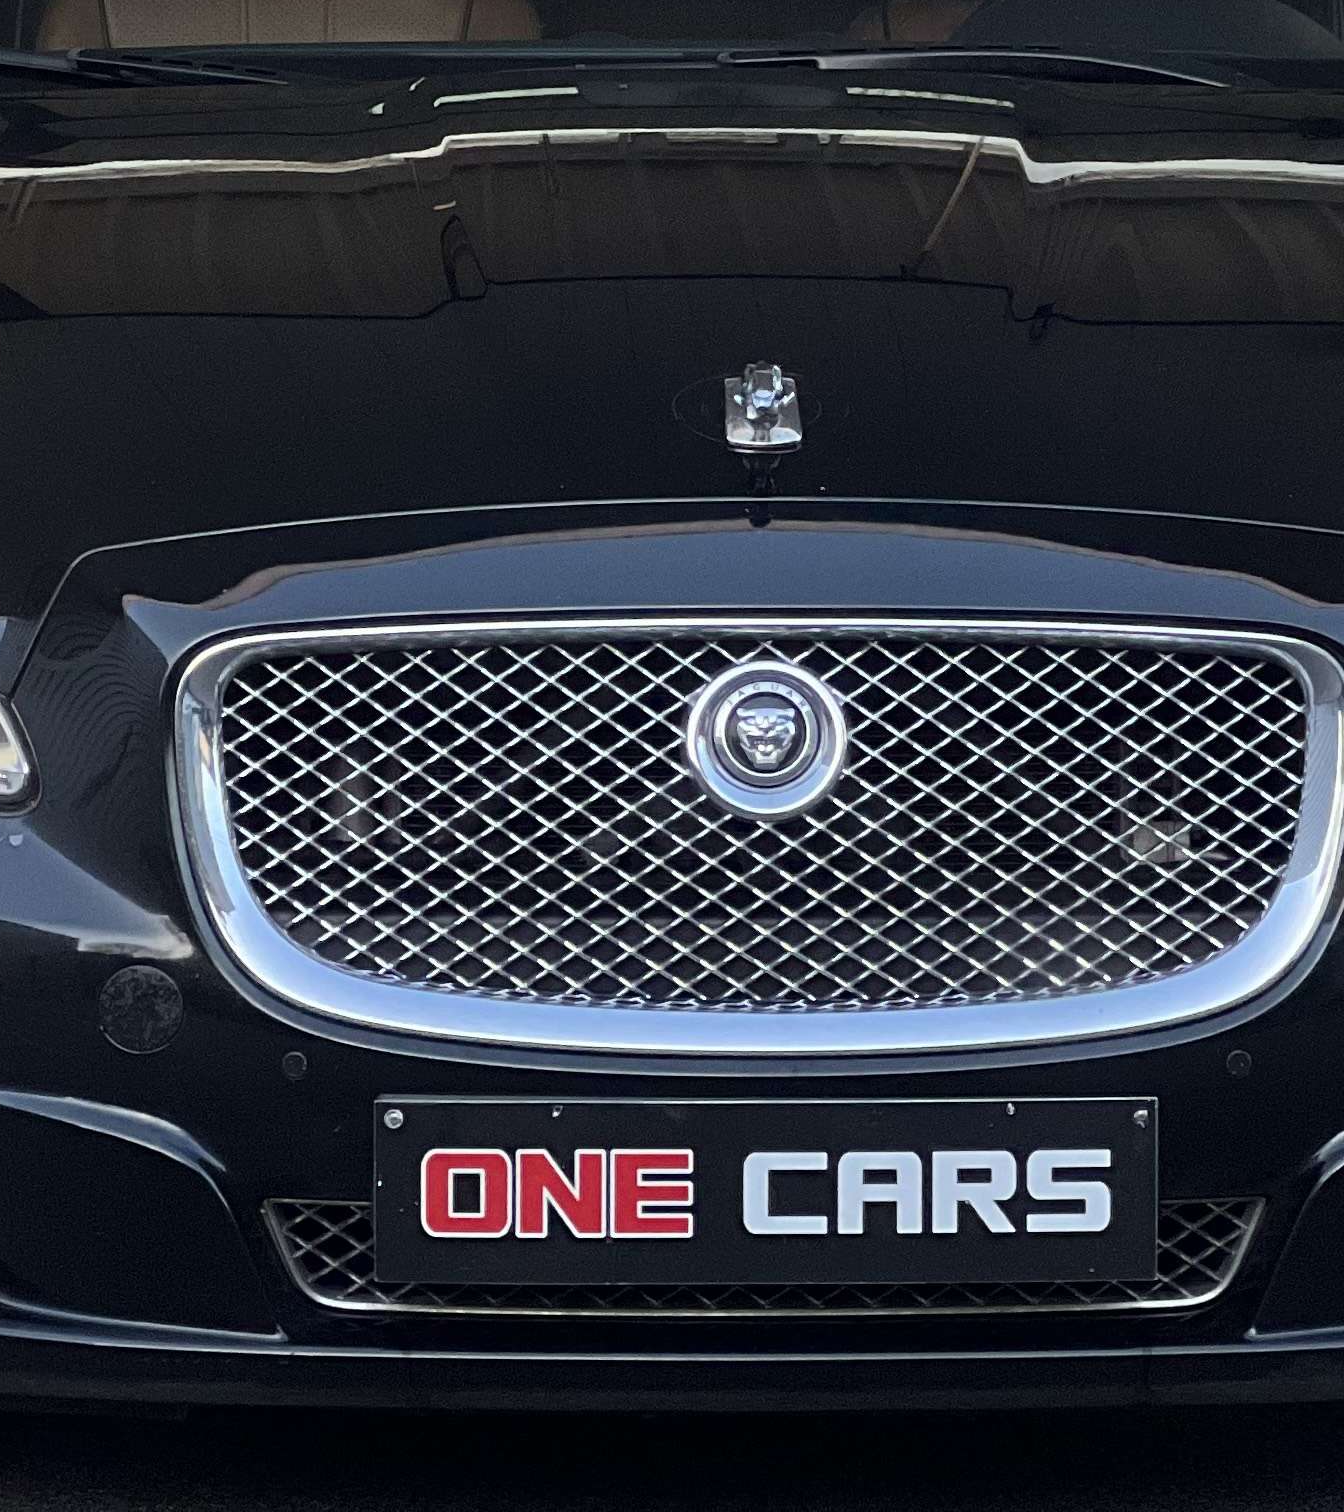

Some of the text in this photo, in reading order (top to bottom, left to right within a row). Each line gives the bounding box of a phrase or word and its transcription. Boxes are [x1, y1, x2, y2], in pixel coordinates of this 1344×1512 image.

[727, 683, 809, 709] JAGUAR
[420, 1147, 1112, 1239] ONE CARS
